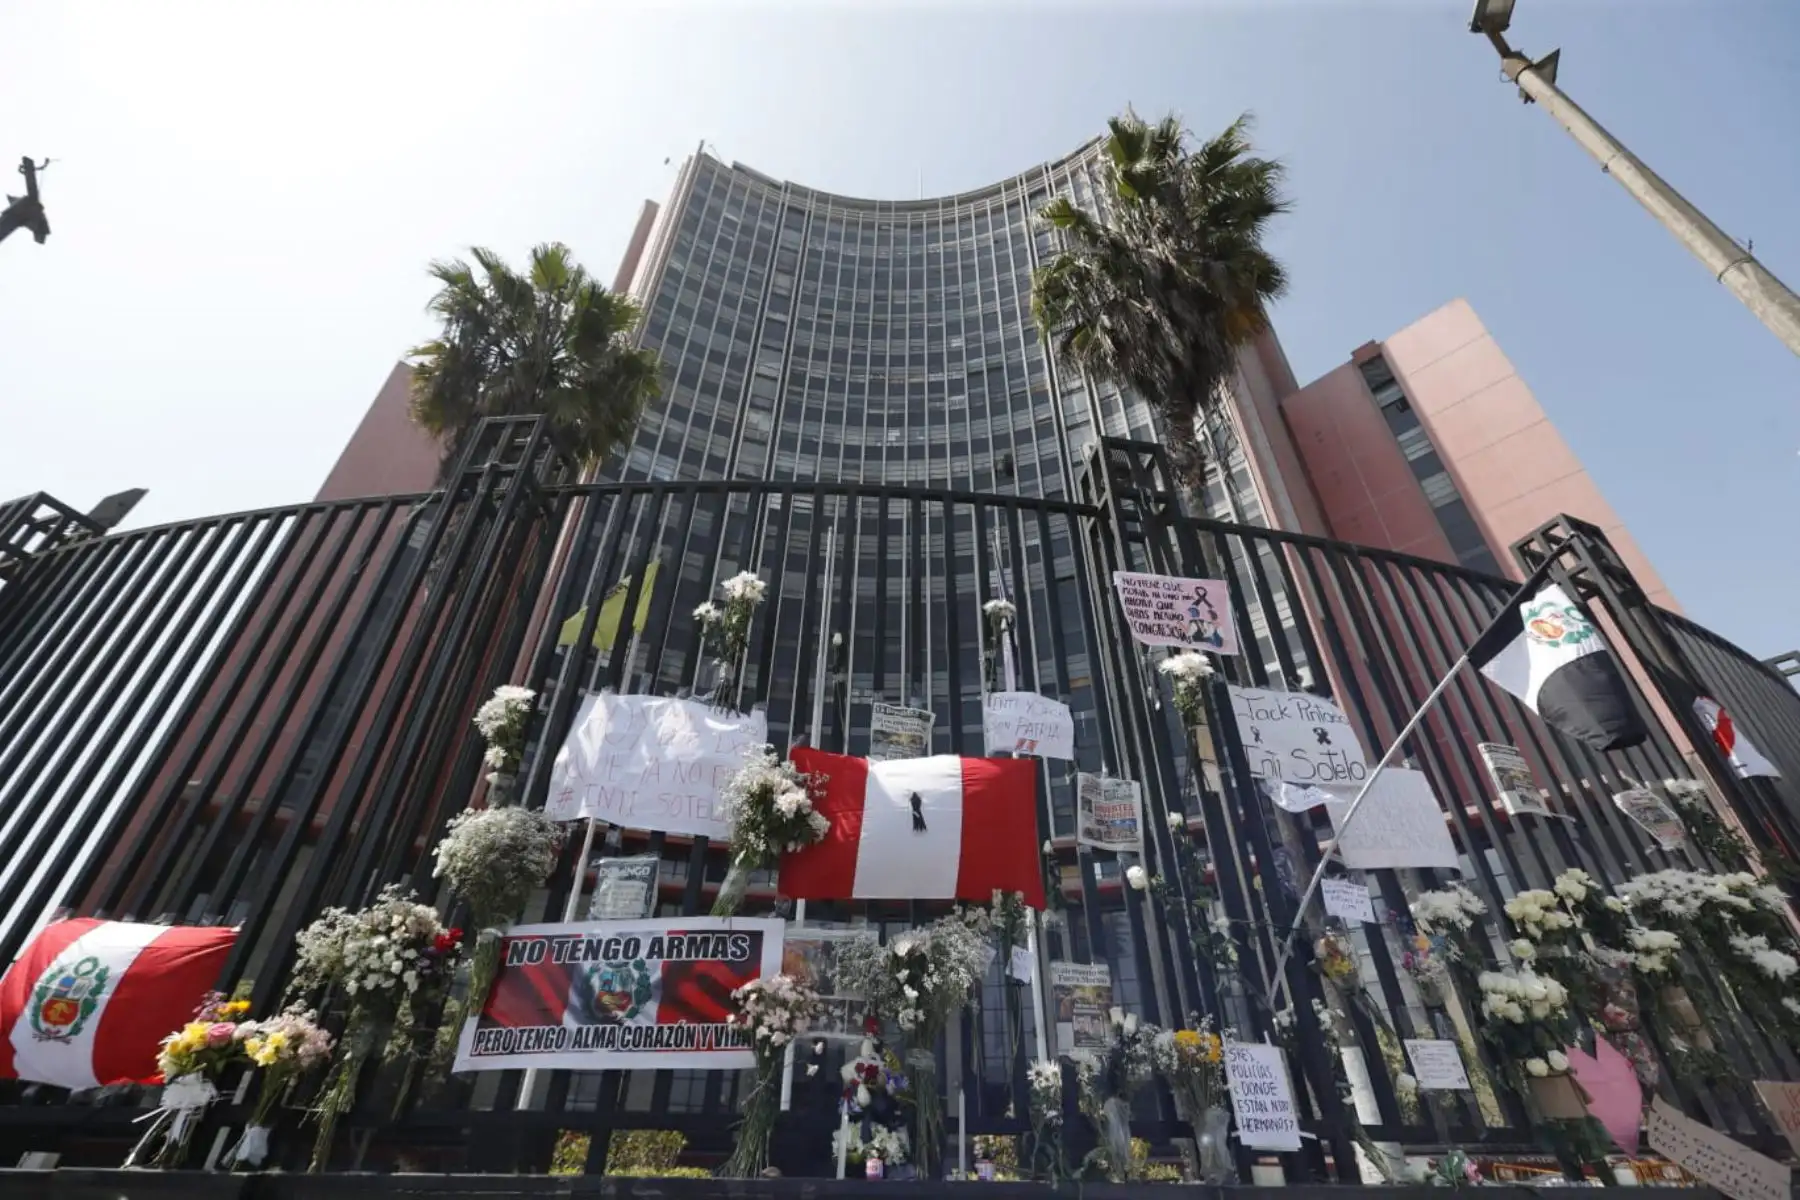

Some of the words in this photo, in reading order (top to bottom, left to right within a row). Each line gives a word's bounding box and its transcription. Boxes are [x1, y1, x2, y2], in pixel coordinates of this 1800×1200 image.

[1235, 694, 1291, 721] Jack
[1291, 747, 1367, 782] Sotelo
[506, 938, 548, 966] NO
[551, 935, 641, 964] TENGO
[645, 933, 751, 961] ARMAS
[472, 1027, 512, 1055] PERO
[513, 1025, 569, 1051] TENGO
[571, 1024, 616, 1050] ALMA
[619, 1018, 694, 1050] CORAZÓN
[699, 1023, 712, 1049] Y
